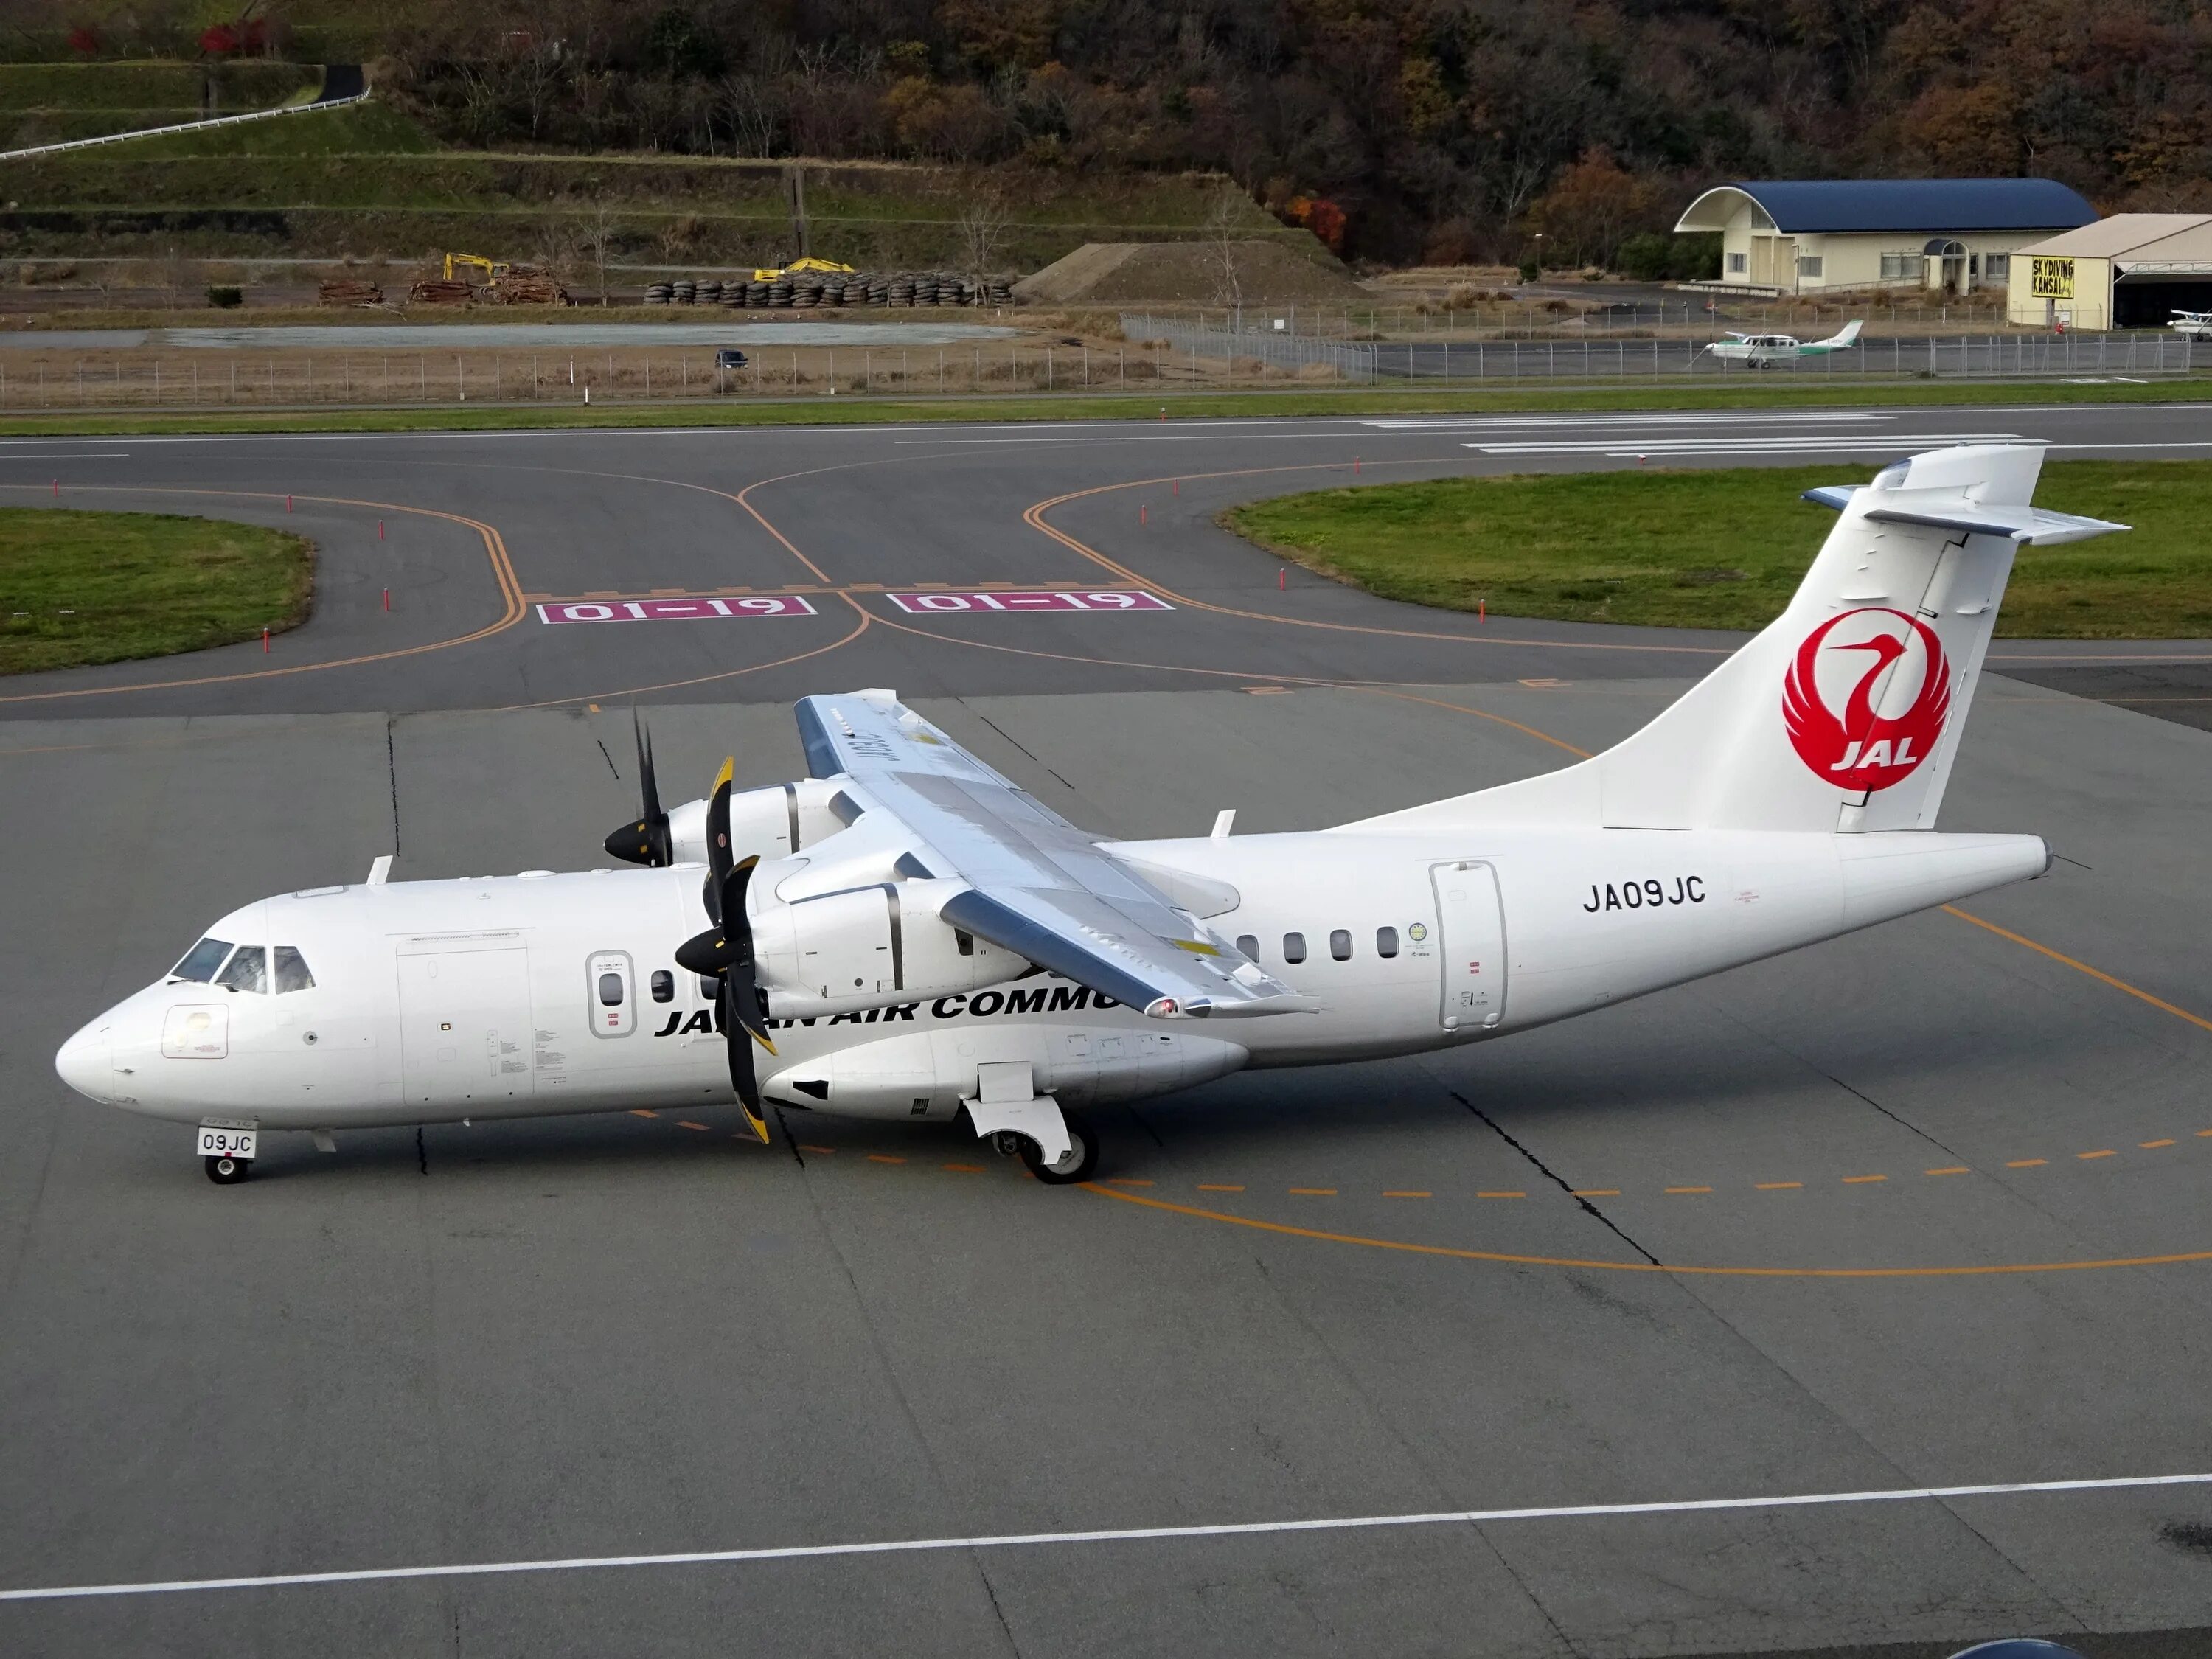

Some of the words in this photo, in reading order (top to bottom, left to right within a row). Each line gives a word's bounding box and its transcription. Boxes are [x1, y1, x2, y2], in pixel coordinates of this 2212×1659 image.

[2033, 258, 2073, 277] SKYDIVING
[2033, 276, 2062, 295] KANSAI
[563, 599, 786, 620] 01-19
[916, 594, 1135, 611] 01-19
[1830, 737, 1918, 771] JAL
[1582, 875, 1706, 913] JA09JC
[204, 1134, 251, 1152] 09JC
